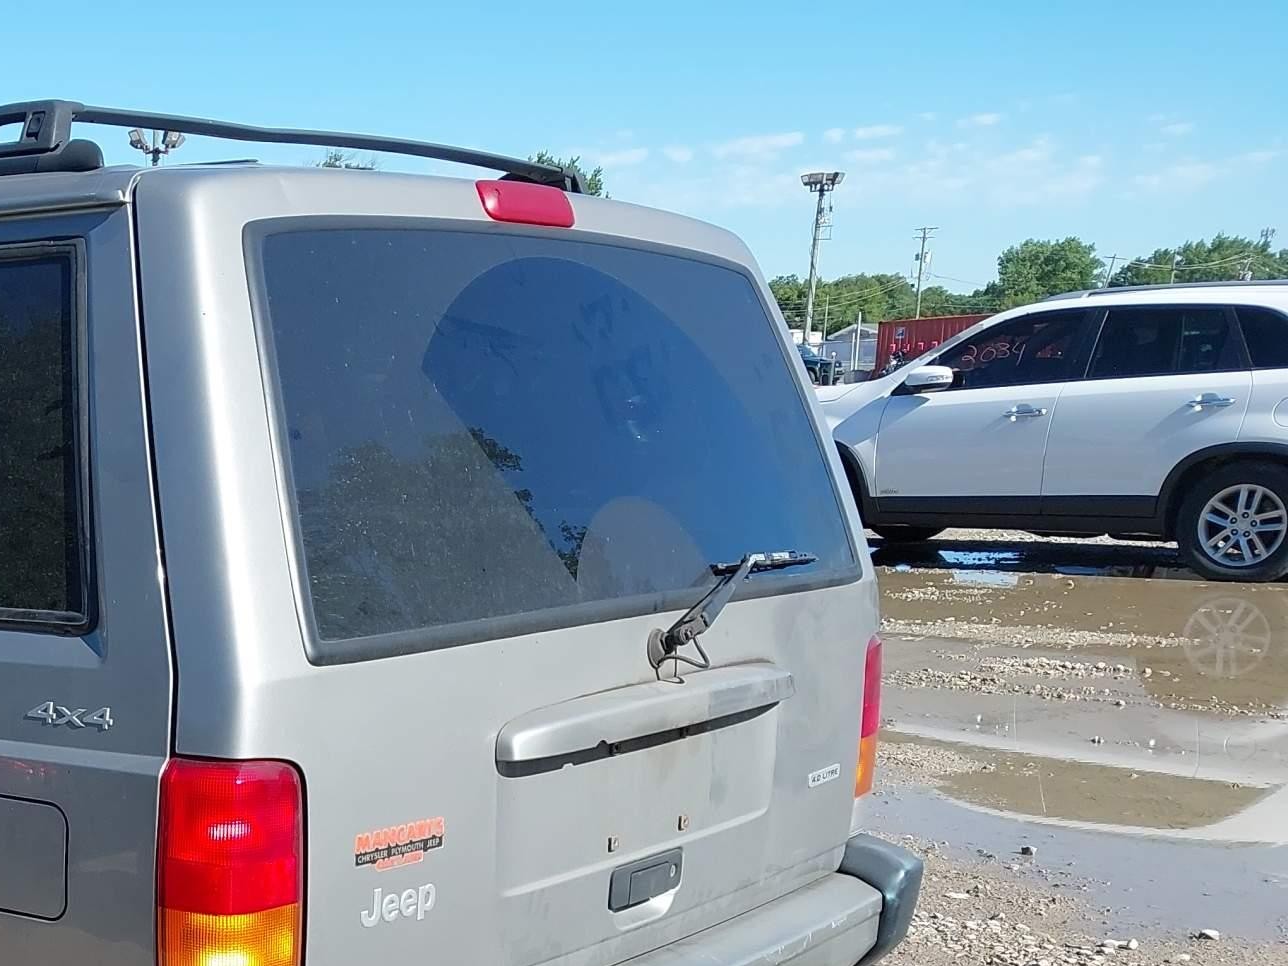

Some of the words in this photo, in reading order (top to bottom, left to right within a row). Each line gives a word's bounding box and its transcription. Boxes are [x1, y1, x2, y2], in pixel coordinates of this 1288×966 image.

[961, 341, 1027, 366] 2034
[357, 848, 388, 864] CHRYSLER
[391, 841, 424, 857] PLYMOUTH
[426, 838, 440, 848] JEEP
[360, 883, 436, 928] Jeep
